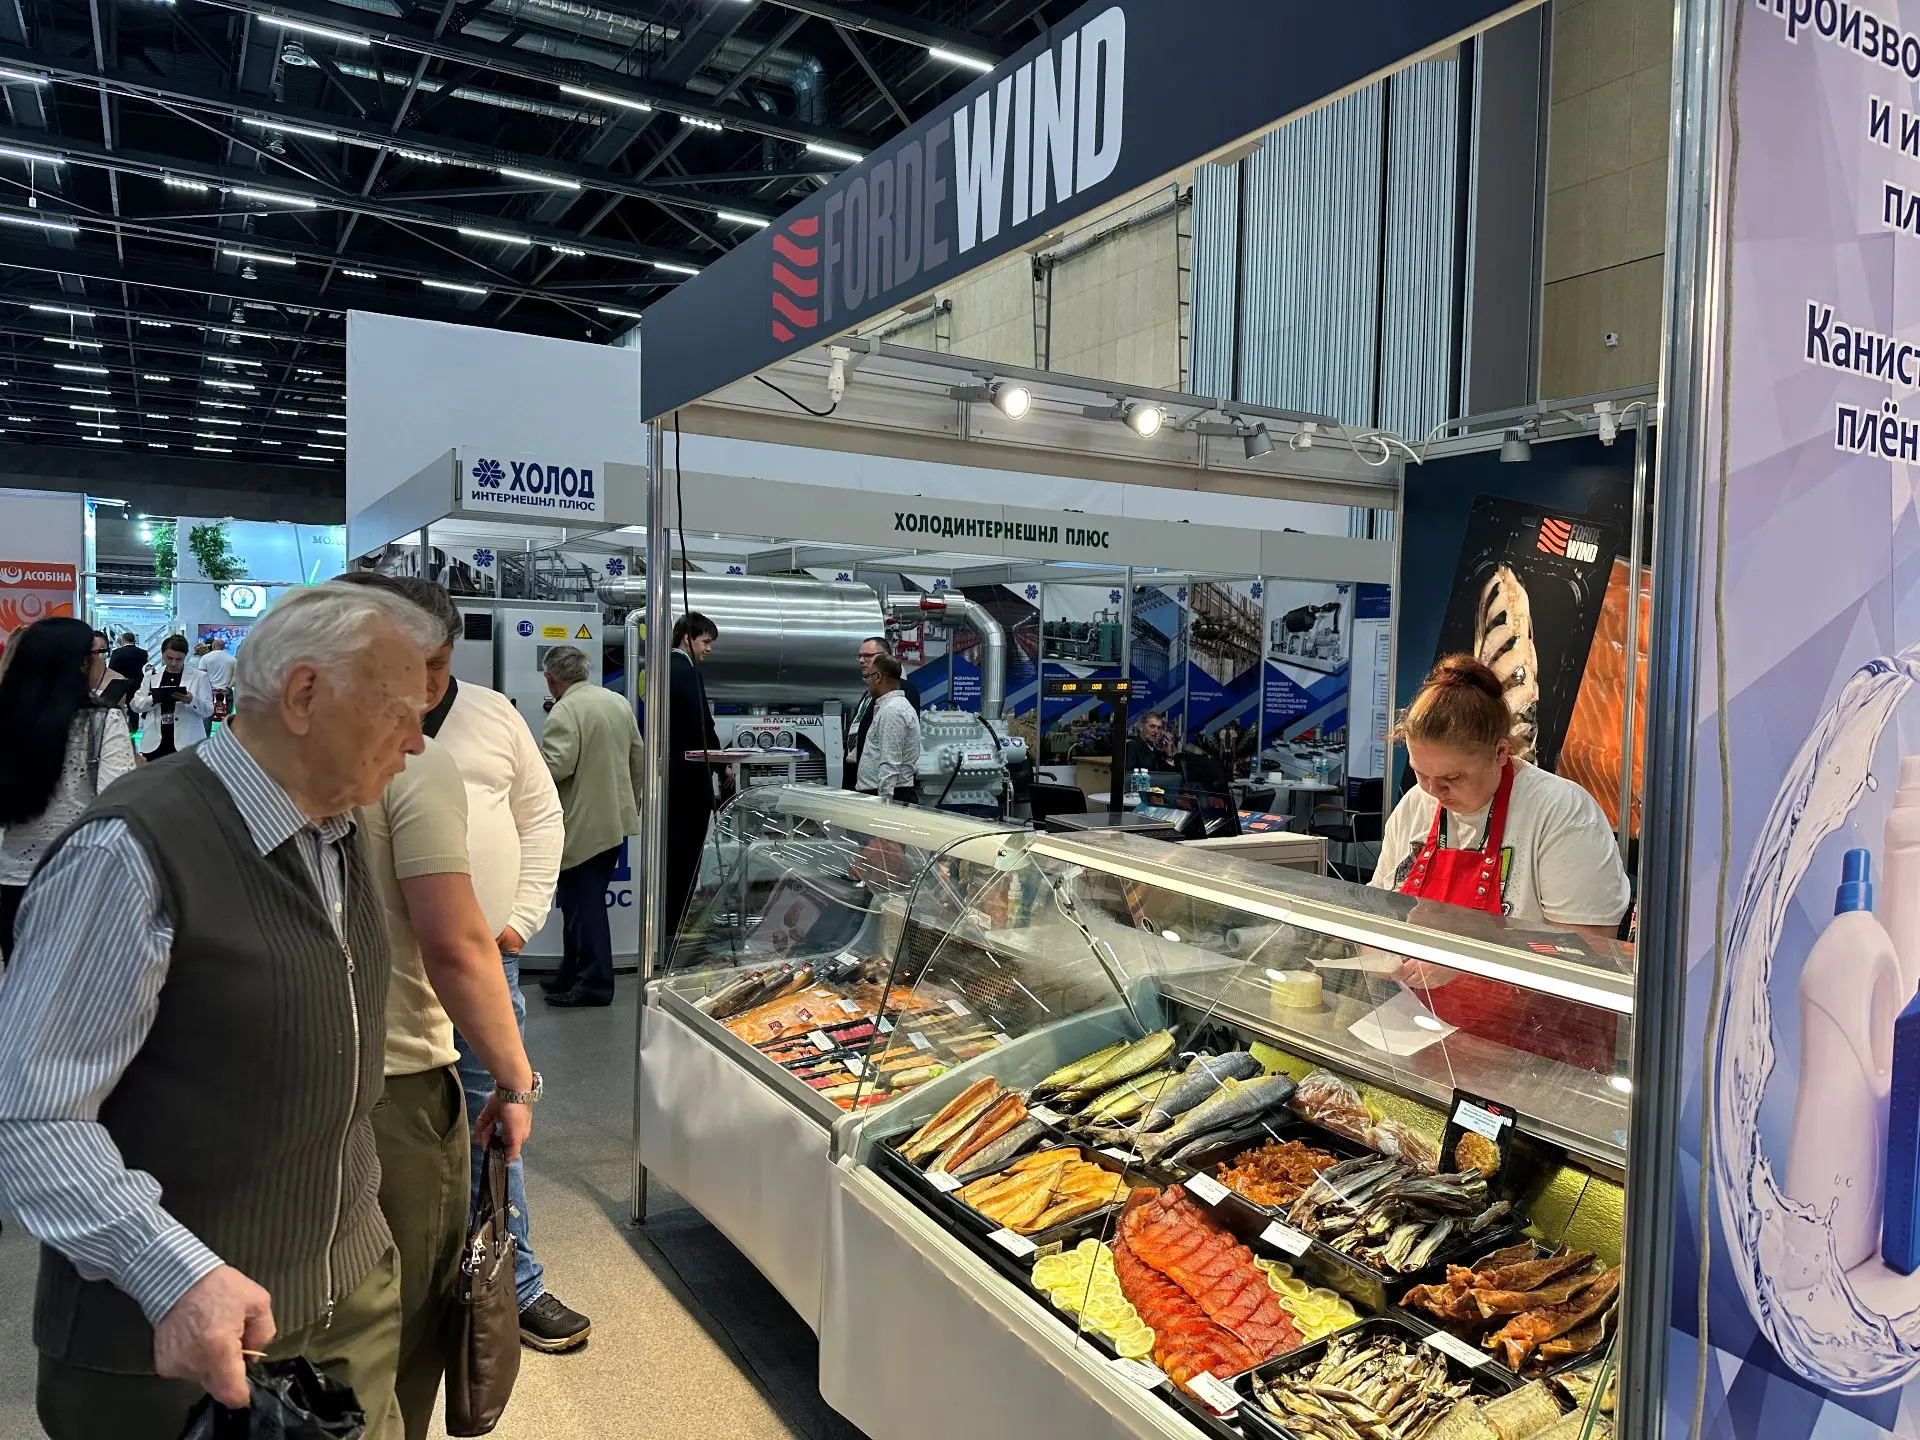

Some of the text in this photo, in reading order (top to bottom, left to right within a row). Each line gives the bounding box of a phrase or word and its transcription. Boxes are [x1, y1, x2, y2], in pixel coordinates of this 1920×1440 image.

[1758, 0, 1920, 79] роизво
[1870, 99, 1891, 144] и
[509, 461, 595, 499] ХОЛОД
[471, 490, 595, 511] ИНТЕРНЕШНЛ ПЛЮС
[894, 512, 1109, 549] ХОЛОДИНТЕРНЕШНЛ ПЛЮС
[1566, 540, 1598, 563] WIND
[23, 571, 72, 582] АСОБІНА
